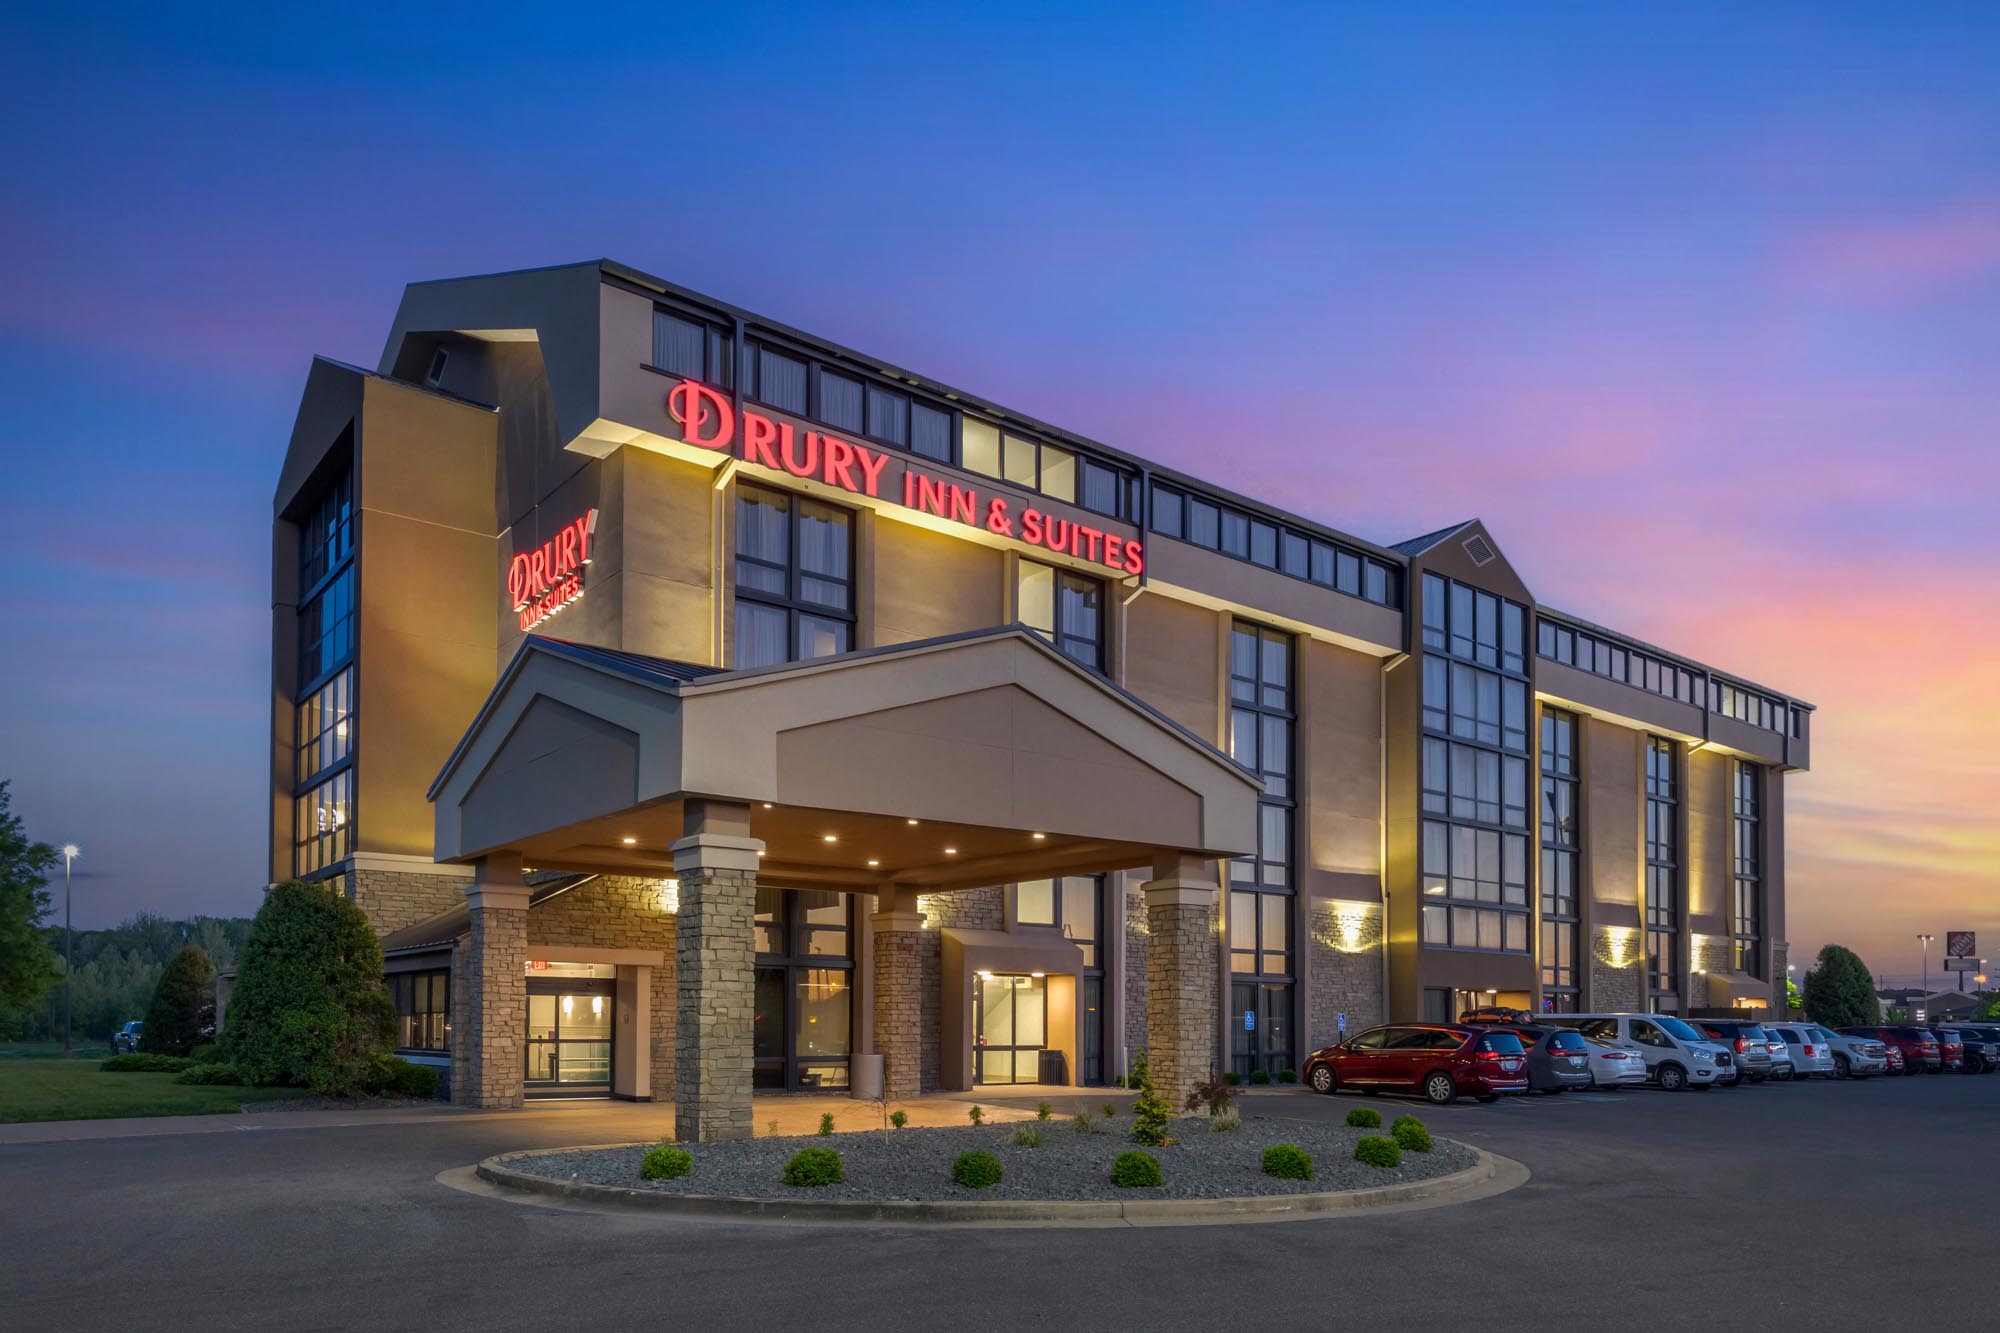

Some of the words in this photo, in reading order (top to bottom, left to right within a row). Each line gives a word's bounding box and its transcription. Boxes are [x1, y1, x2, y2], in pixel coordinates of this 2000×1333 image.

[668, 380, 889, 497] DRURY
[905, 471, 976, 525] INN
[987, 498, 1013, 537] &
[1021, 508, 1143, 575] SUITES
[508, 509, 593, 609] DRURY
[520, 604, 536, 630] INN
[544, 575, 579, 613] SUITES
